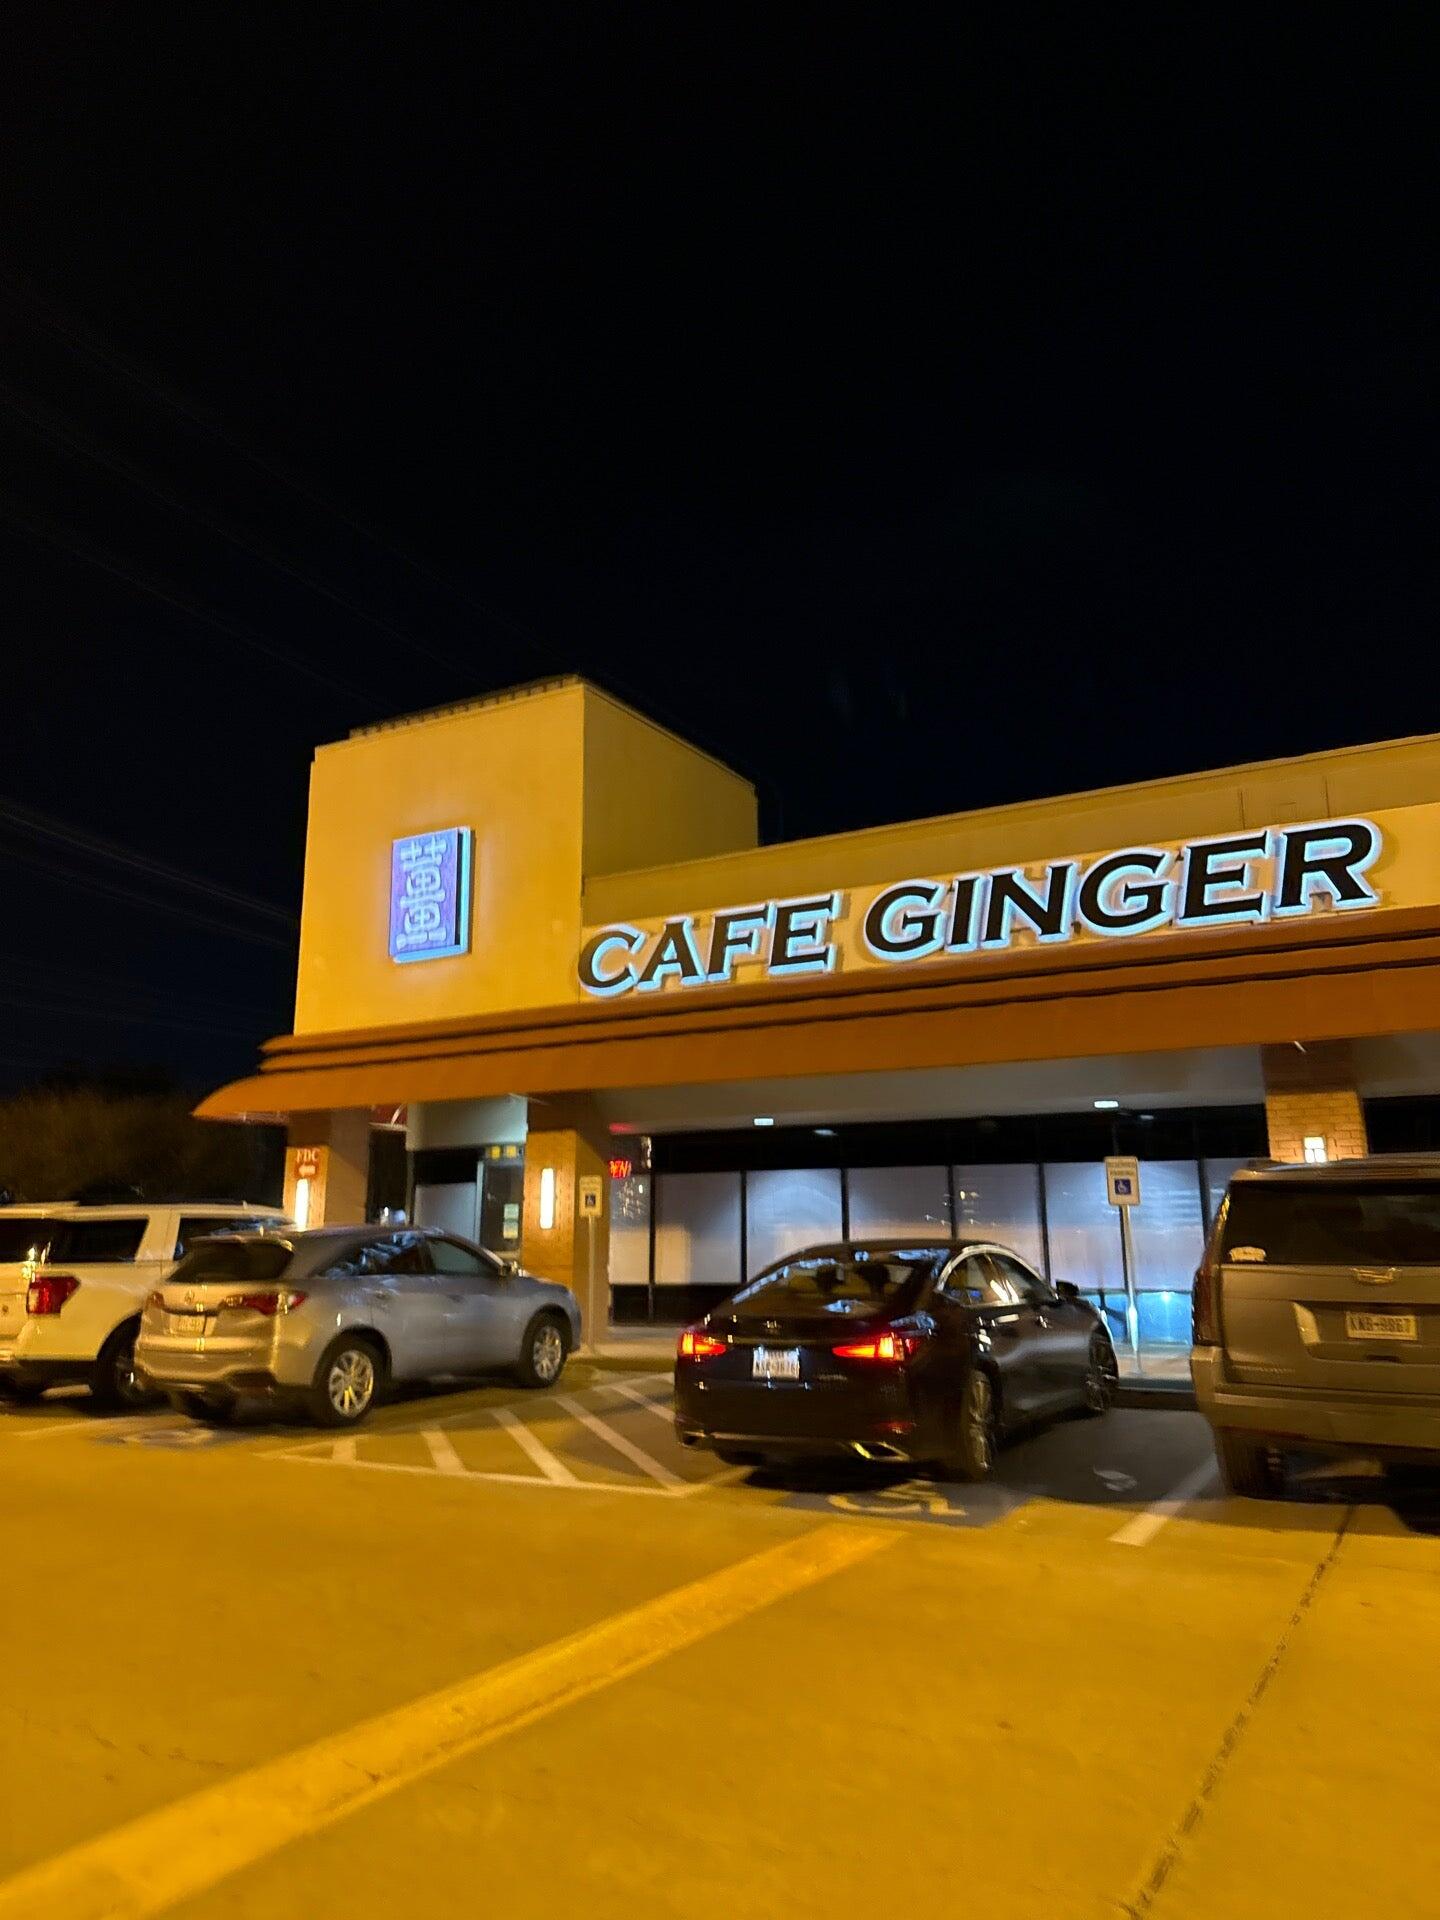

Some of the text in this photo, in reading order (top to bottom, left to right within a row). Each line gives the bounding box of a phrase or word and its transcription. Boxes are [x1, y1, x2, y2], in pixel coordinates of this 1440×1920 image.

[577, 819, 1381, 996] CAFE GINGER
[296, 1148, 320, 1162] FDC
